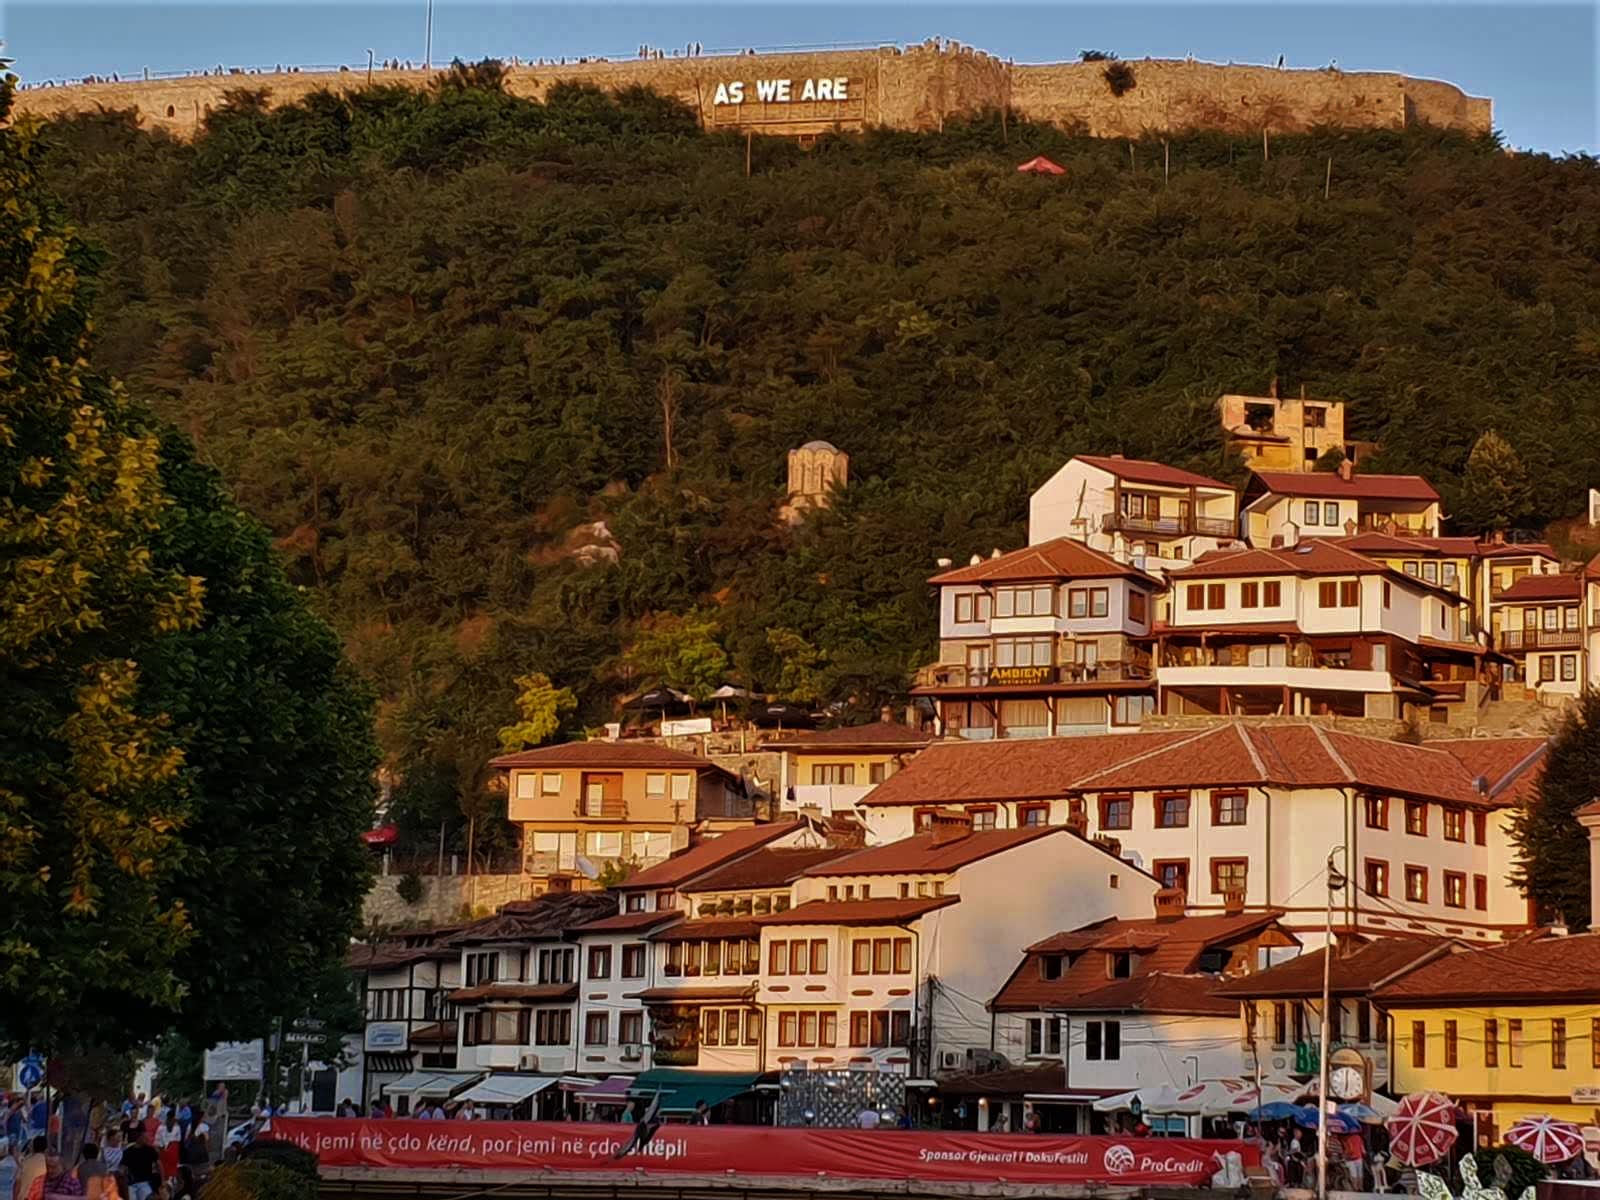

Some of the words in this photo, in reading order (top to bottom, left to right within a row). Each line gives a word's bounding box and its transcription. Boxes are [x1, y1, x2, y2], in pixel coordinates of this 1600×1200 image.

[713, 81, 744, 105] AS
[756, 79, 792, 102] WE
[801, 77, 848, 101] ARE
[990, 667, 1050, 679] AMBIENT
[315, 1132, 355, 1155] jemi
[361, 1133, 384, 1150] në
[388, 1133, 421, 1155] çdo
[427, 1133, 476, 1153] kënd,
[482, 1139, 512, 1156] por
[516, 1135, 556, 1156] jemi
[562, 1137, 584, 1154] në
[589, 1137, 620, 1159] çdo
[918, 1148, 968, 1163] Sponsor
[969, 1150, 1018, 1164] Gjeneral
[1140, 1157, 1204, 1173] ProCredit
